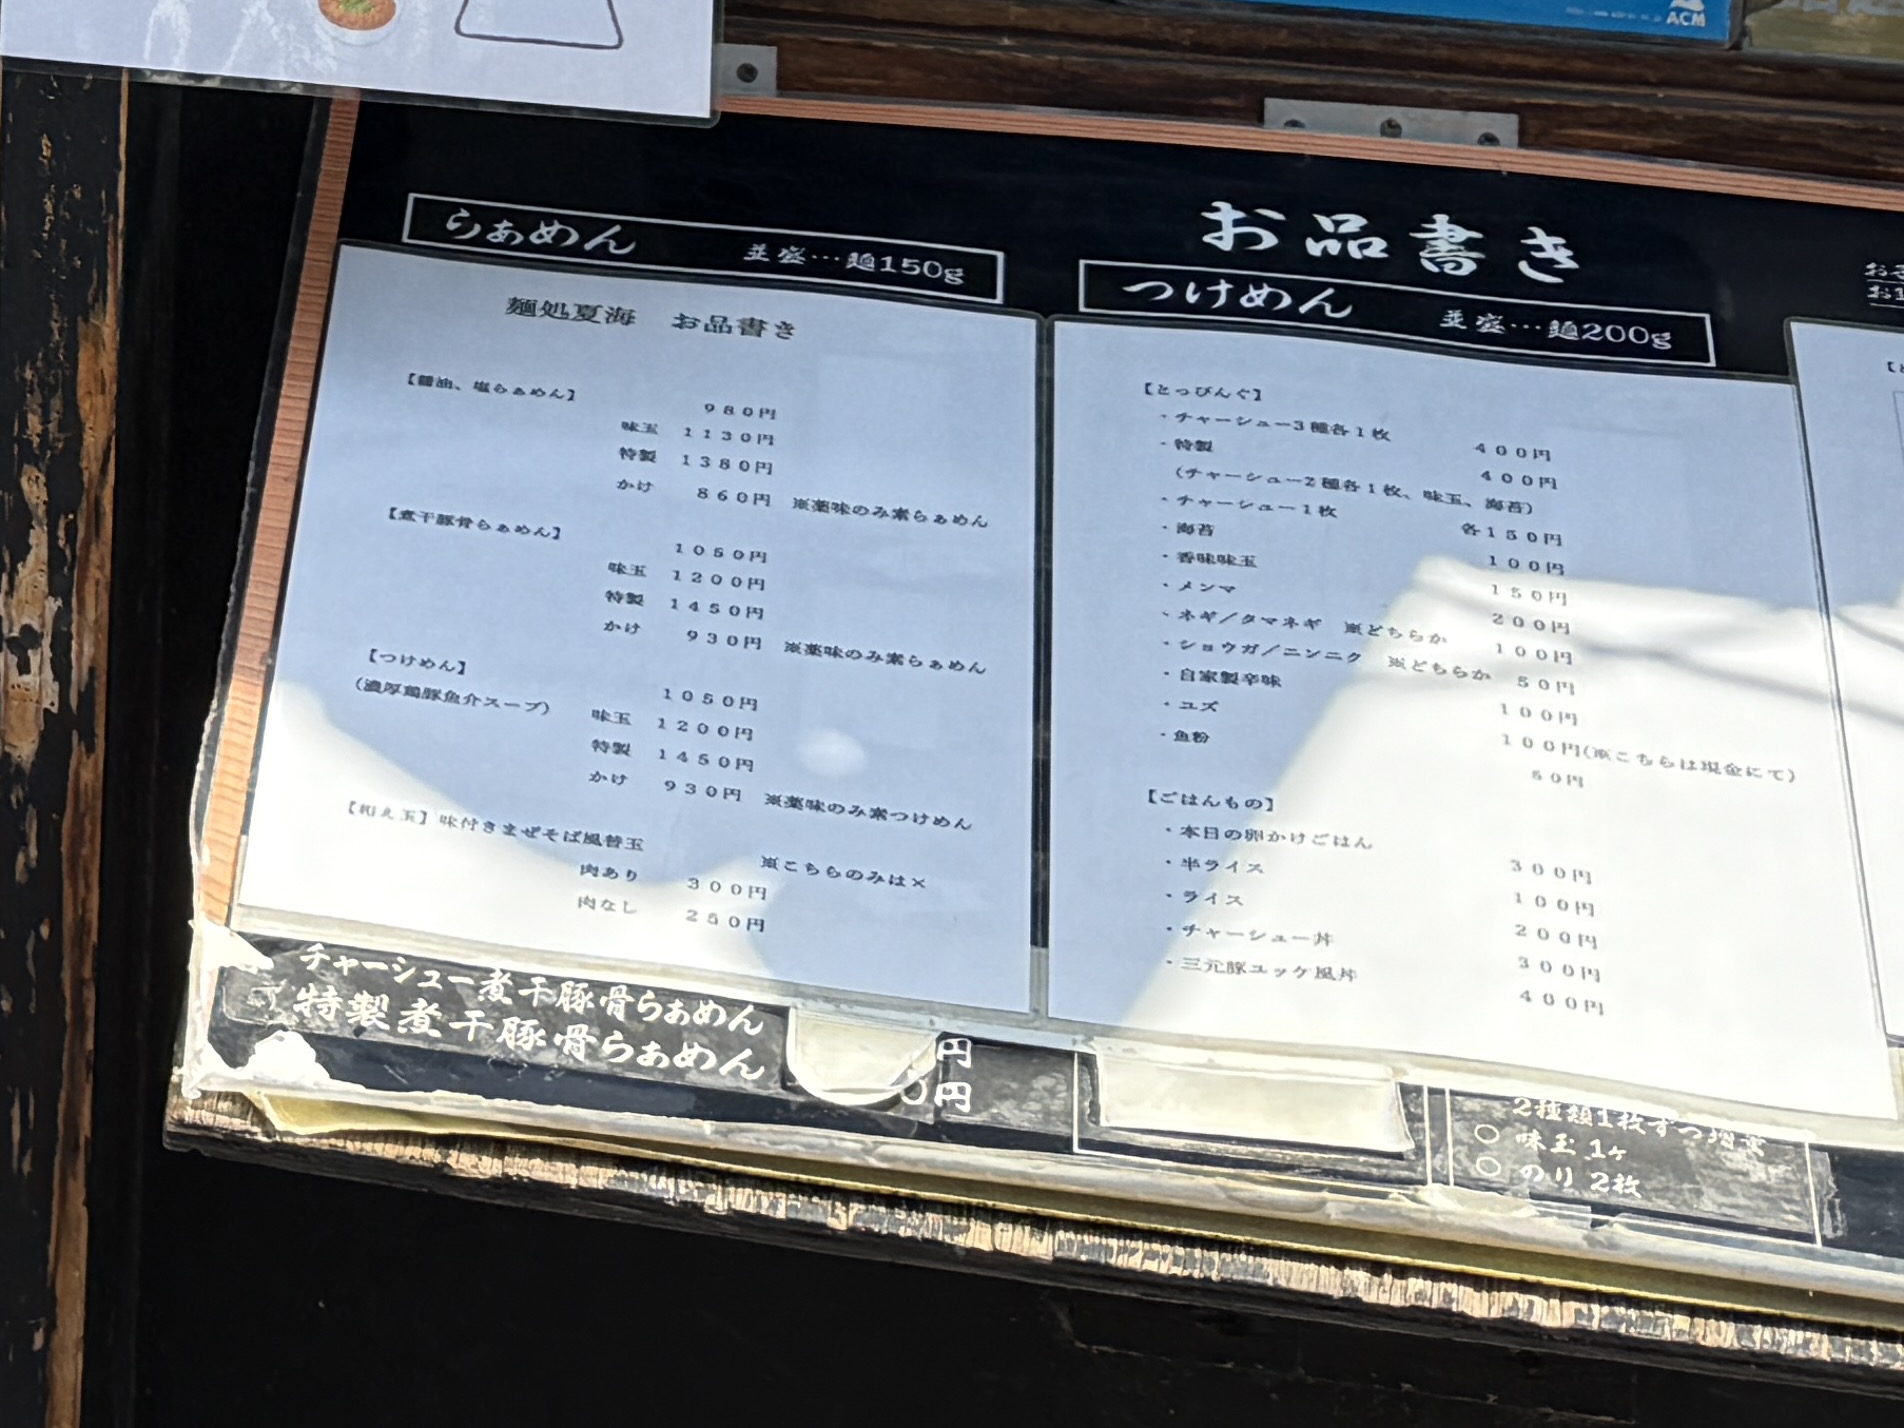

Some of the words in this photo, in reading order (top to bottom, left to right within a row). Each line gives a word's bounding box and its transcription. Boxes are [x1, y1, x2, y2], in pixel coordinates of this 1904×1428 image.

[1667, 11, 1706, 27] ACM
[444, 208, 637, 255] らぁめん
[1202, 202, 1583, 285] お品書き
[506, 294, 636, 326] 麺処夏海
[671, 311, 798, 340] お品書き
[1123, 278, 1353, 320] つけめん
[619, 445, 657, 464] 特製
[299, 946, 765, 1037] チャーシュー煮干豚骨らぁめん
[296, 983, 765, 1081] 特製煮干豚骨らぁめん
